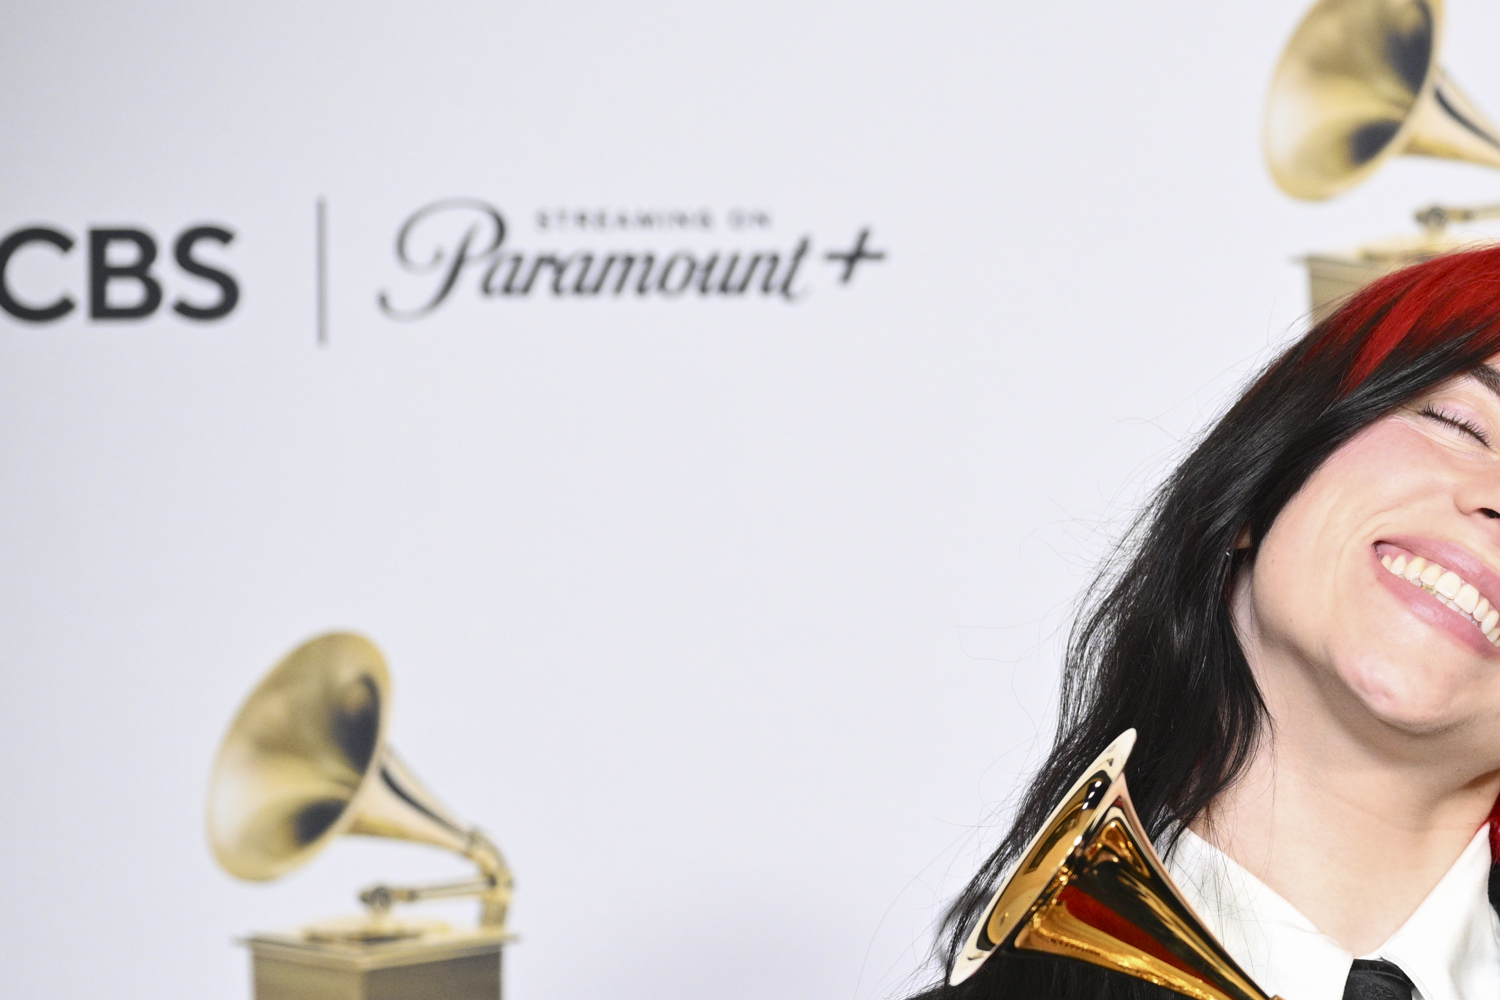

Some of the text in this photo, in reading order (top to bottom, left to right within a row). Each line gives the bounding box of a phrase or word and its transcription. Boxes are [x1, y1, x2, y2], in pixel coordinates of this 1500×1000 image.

[376, 198, 888, 320] Paramount+
[534, 208, 774, 231] STREAMING ON
[0, 223, 241, 327] CBS
